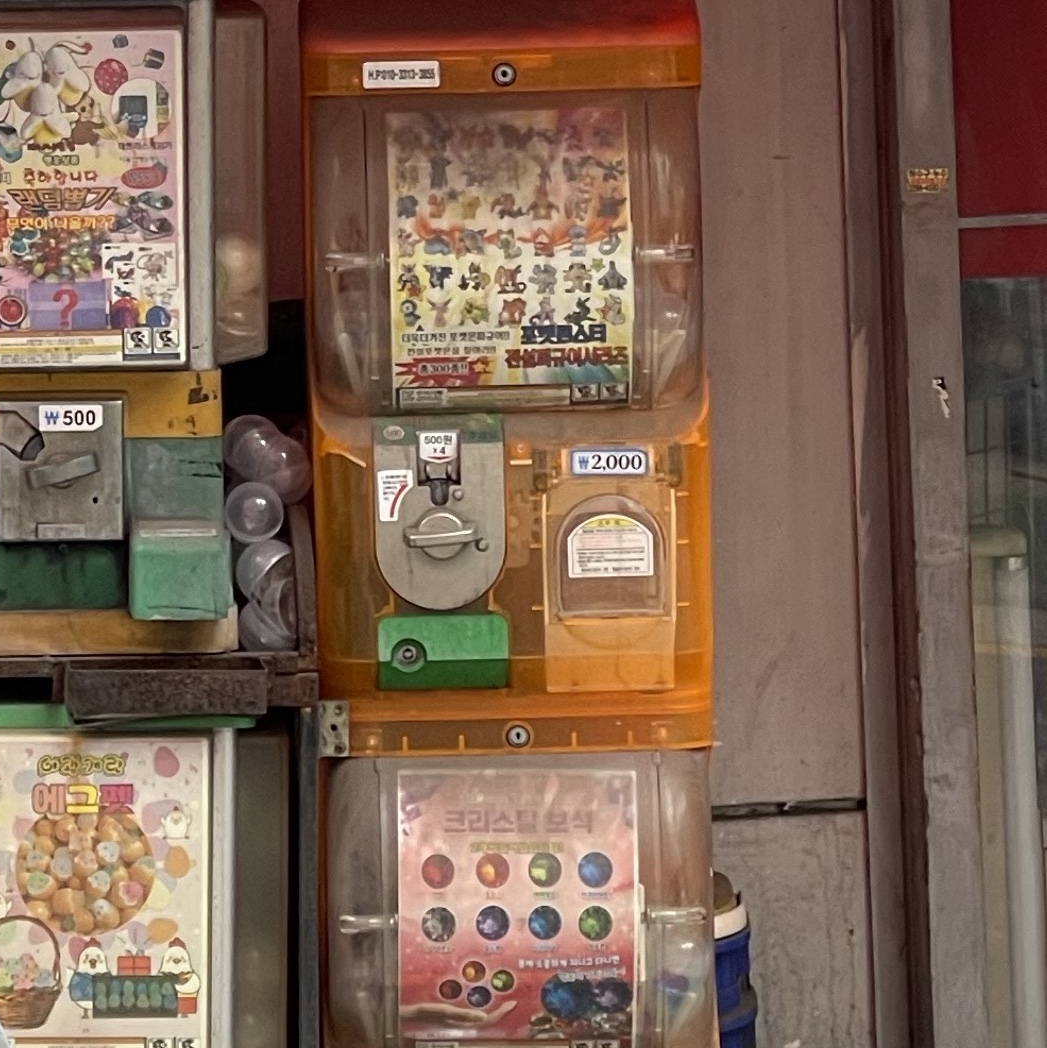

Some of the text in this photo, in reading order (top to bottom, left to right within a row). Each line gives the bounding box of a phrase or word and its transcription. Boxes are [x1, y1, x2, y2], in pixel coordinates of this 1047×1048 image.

[7, 187, 118, 211] 랜덤뽑기
[7, 216, 49, 230] 무엇이
[424, 435, 453, 446] 500원
